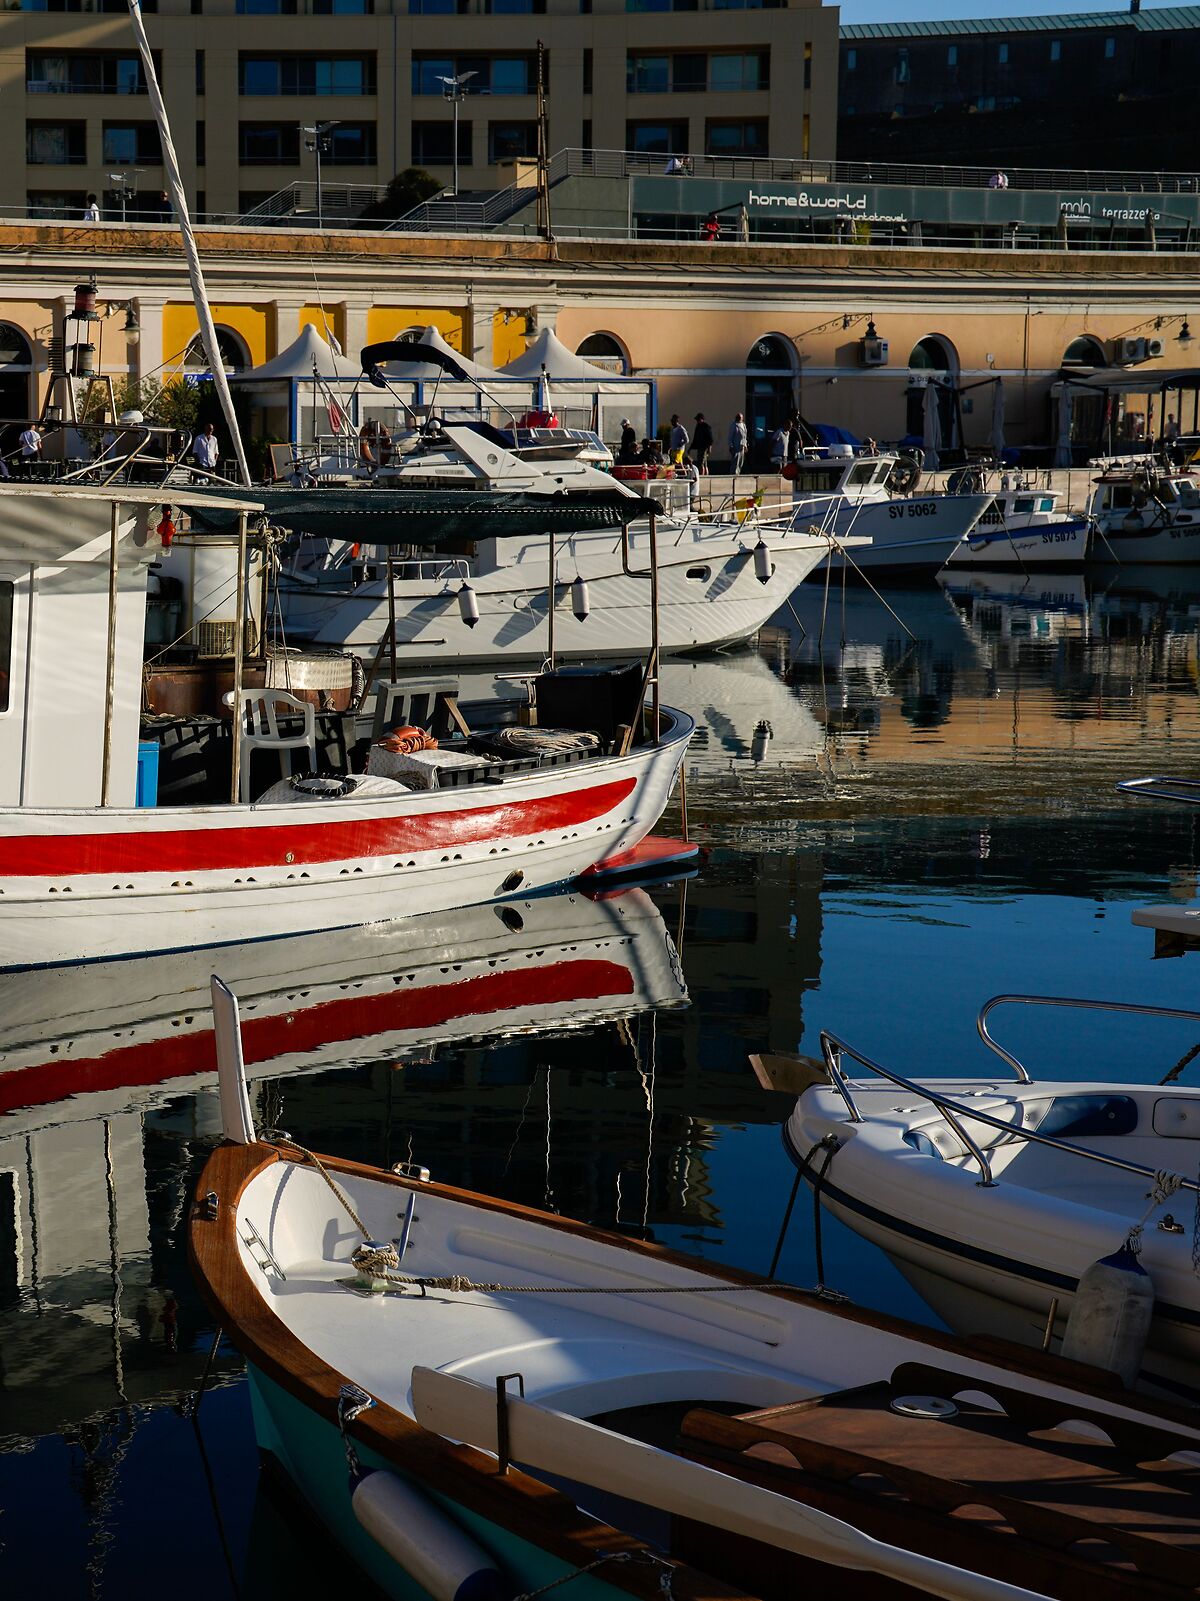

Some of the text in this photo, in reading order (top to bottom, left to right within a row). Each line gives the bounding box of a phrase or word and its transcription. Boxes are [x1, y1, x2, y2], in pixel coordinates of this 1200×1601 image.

[749, 190, 867, 209] home&world
[1102, 207, 1160, 220] terrazzeta
[888, 502, 938, 519] SV 5062
[1041, 530, 1078, 544] SV 5073
